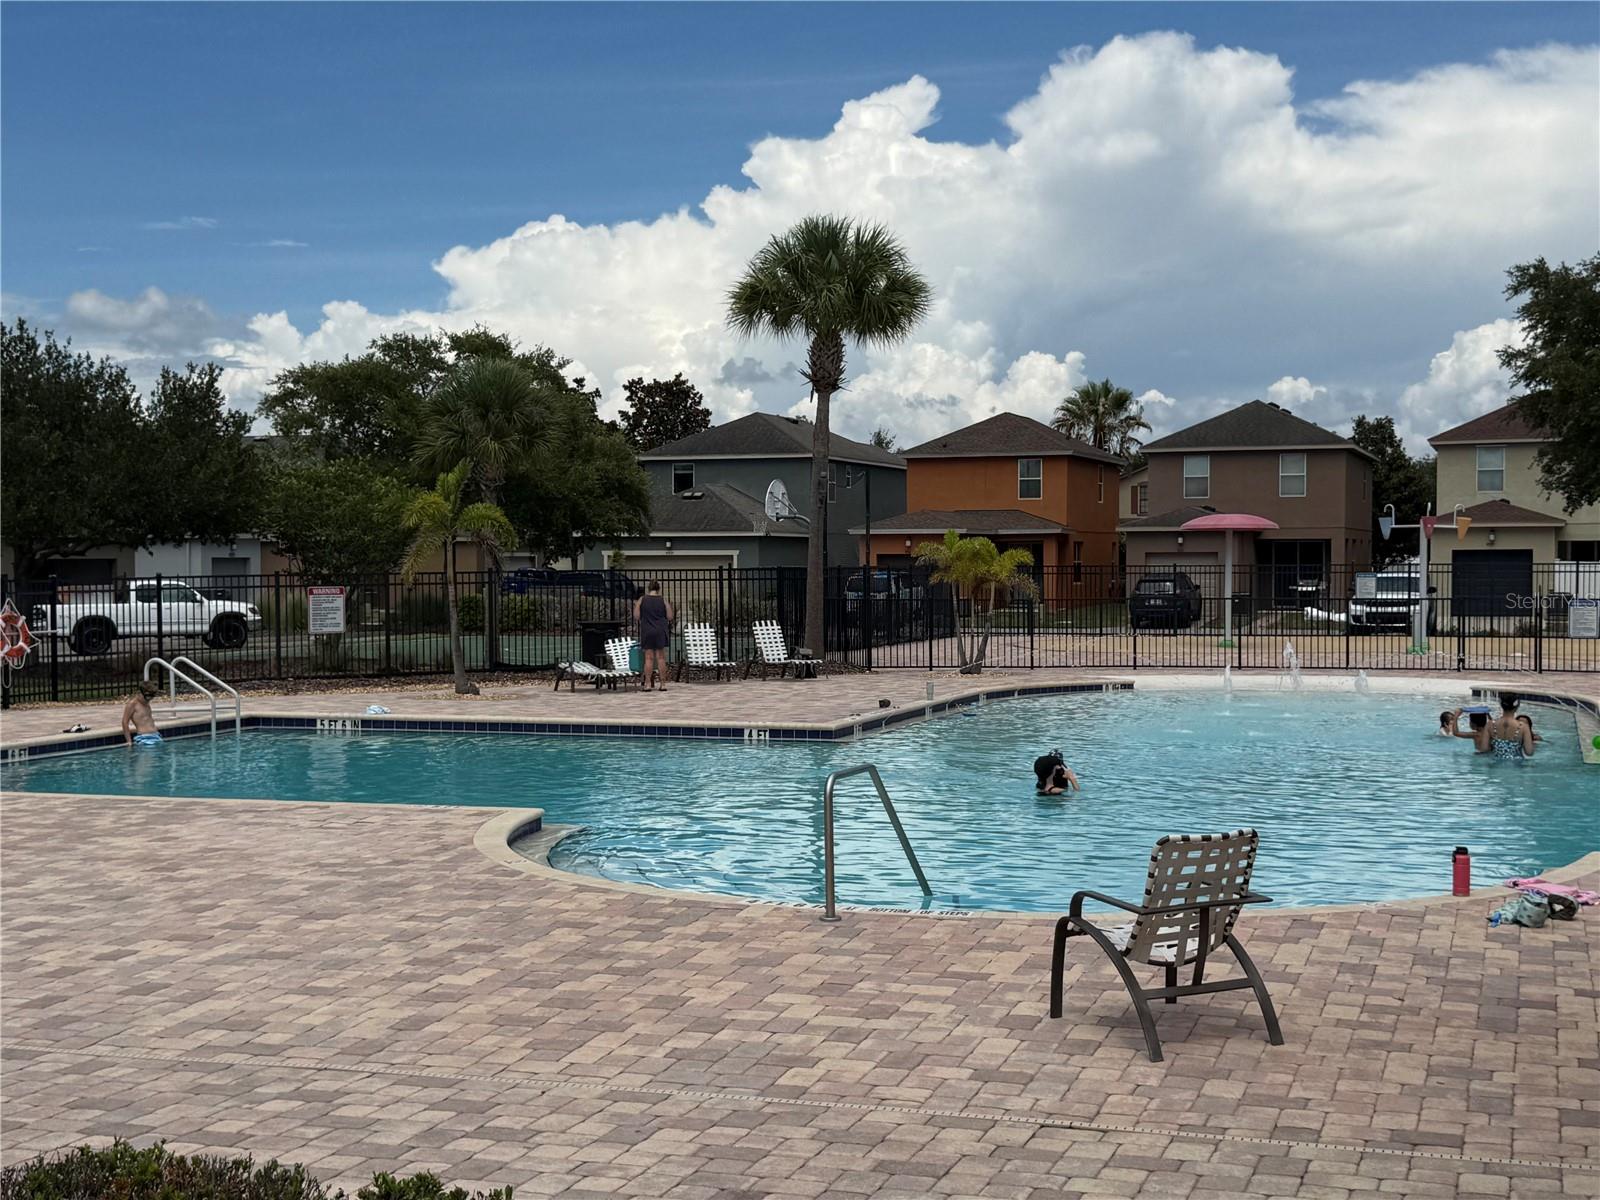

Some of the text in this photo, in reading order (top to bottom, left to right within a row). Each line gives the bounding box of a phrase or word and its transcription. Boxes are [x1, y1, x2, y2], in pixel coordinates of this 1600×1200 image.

[329, 719, 339, 729] FT
[351, 719, 360, 729] IN
[748, 728, 768, 738] 4 FT
